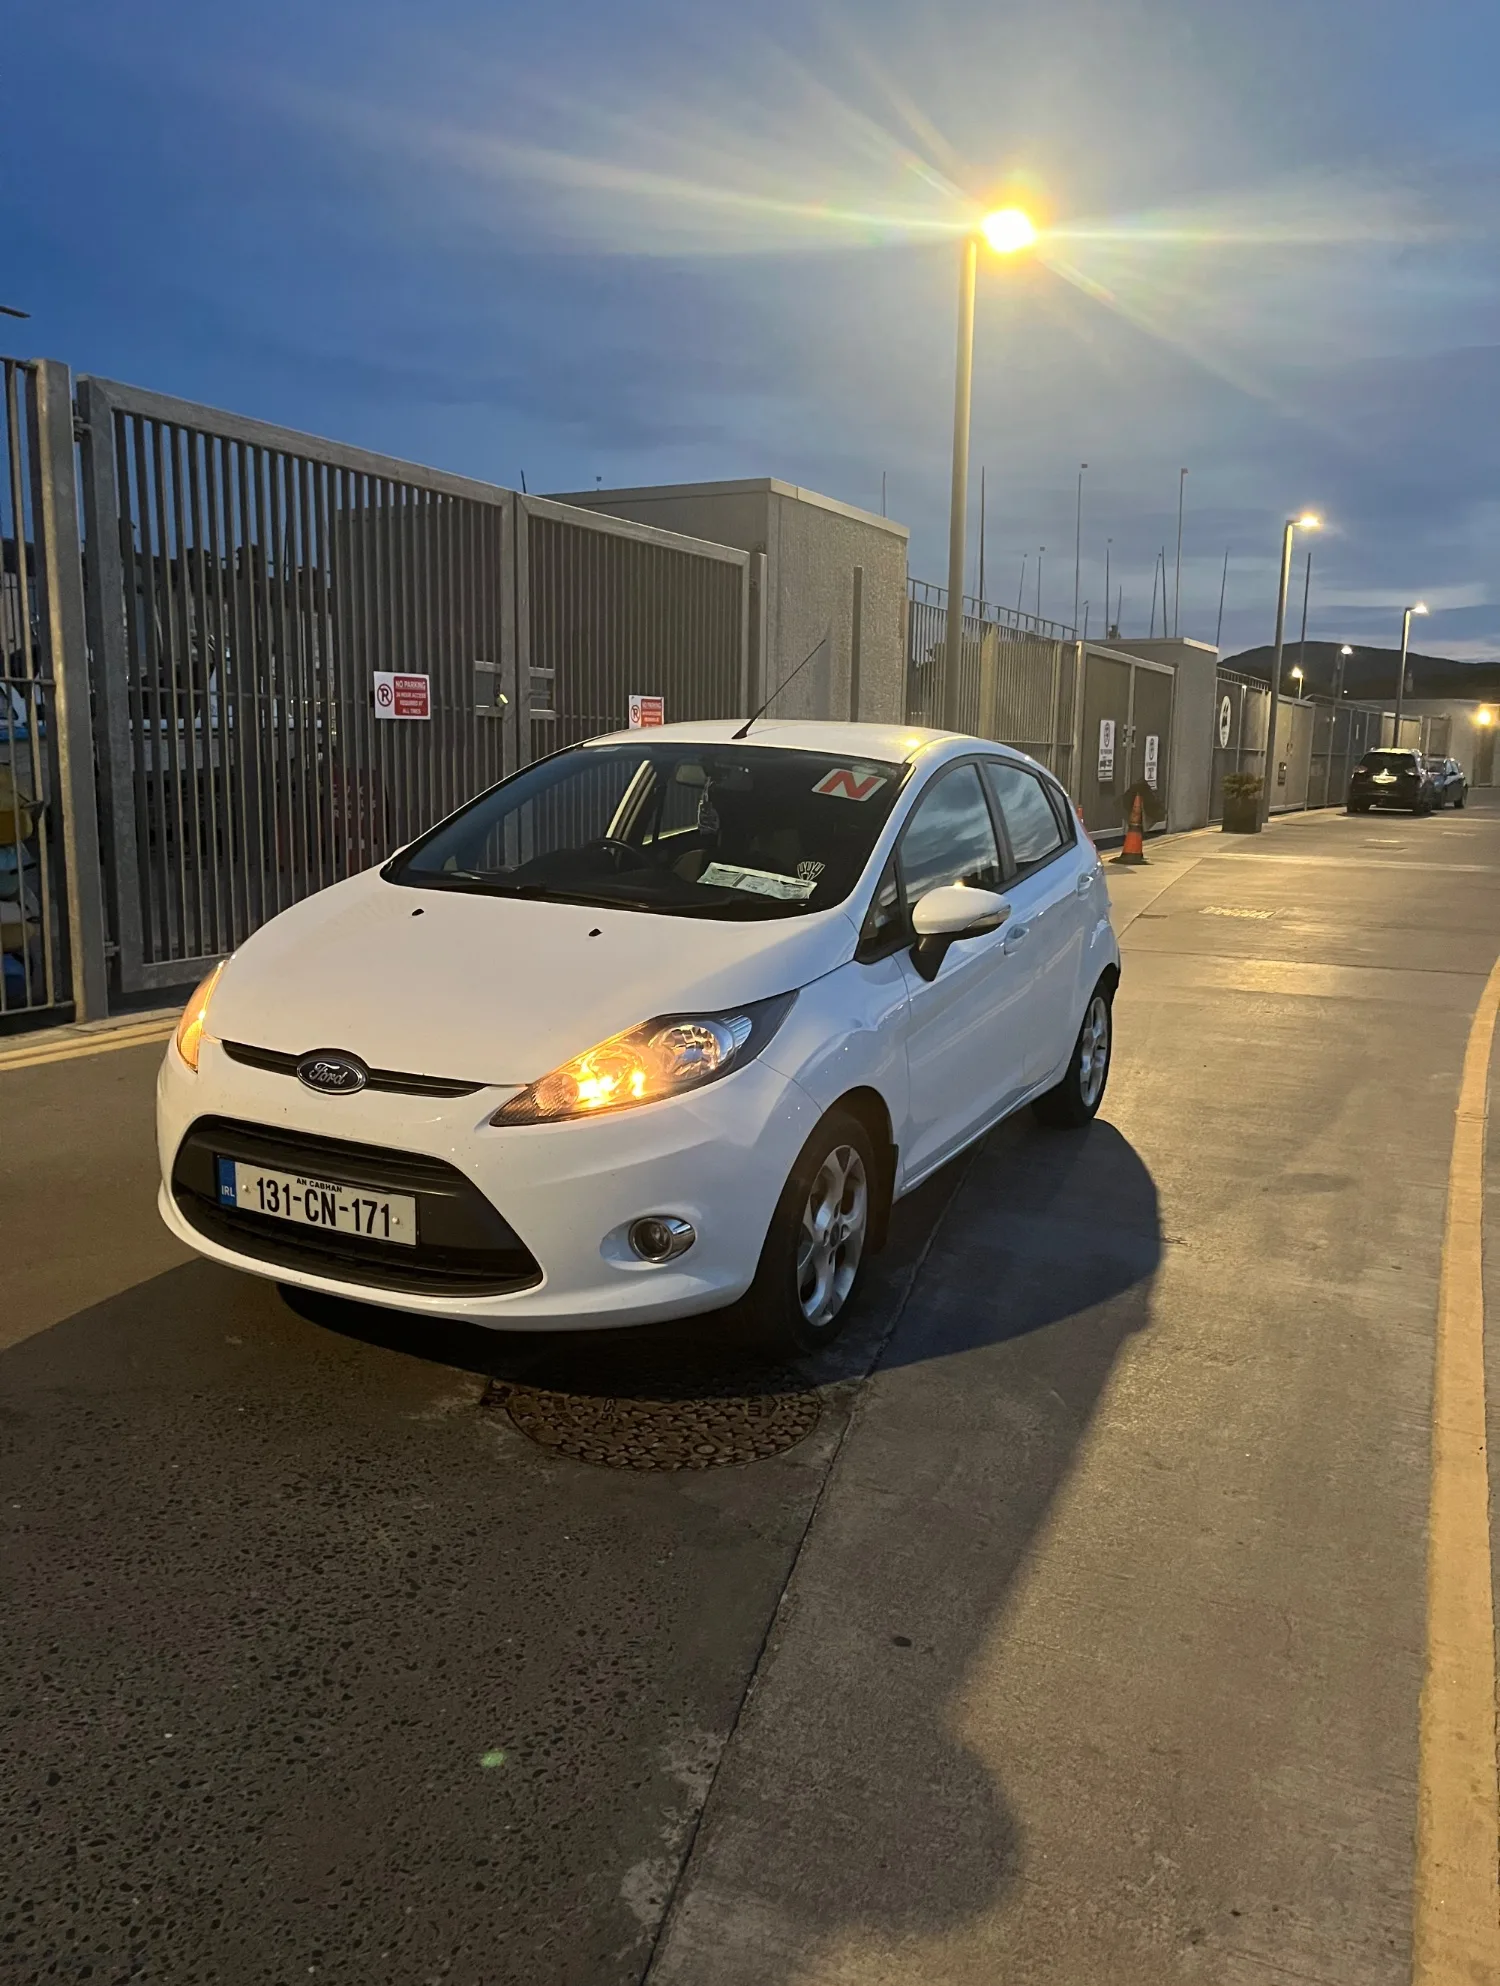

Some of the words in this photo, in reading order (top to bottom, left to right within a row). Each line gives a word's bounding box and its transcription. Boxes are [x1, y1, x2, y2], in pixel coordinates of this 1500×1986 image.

[395, 680, 403, 688] NO
[404, 680, 426, 690] PARKING
[818, 770, 882, 799] N
[308, 1062, 348, 1085] Ford
[221, 1184, 236, 1198] IRL
[296, 1177, 308, 1186] AN
[309, 1179, 343, 1193] CABHAN
[256, 1176, 390, 1238] 131-CN-171
